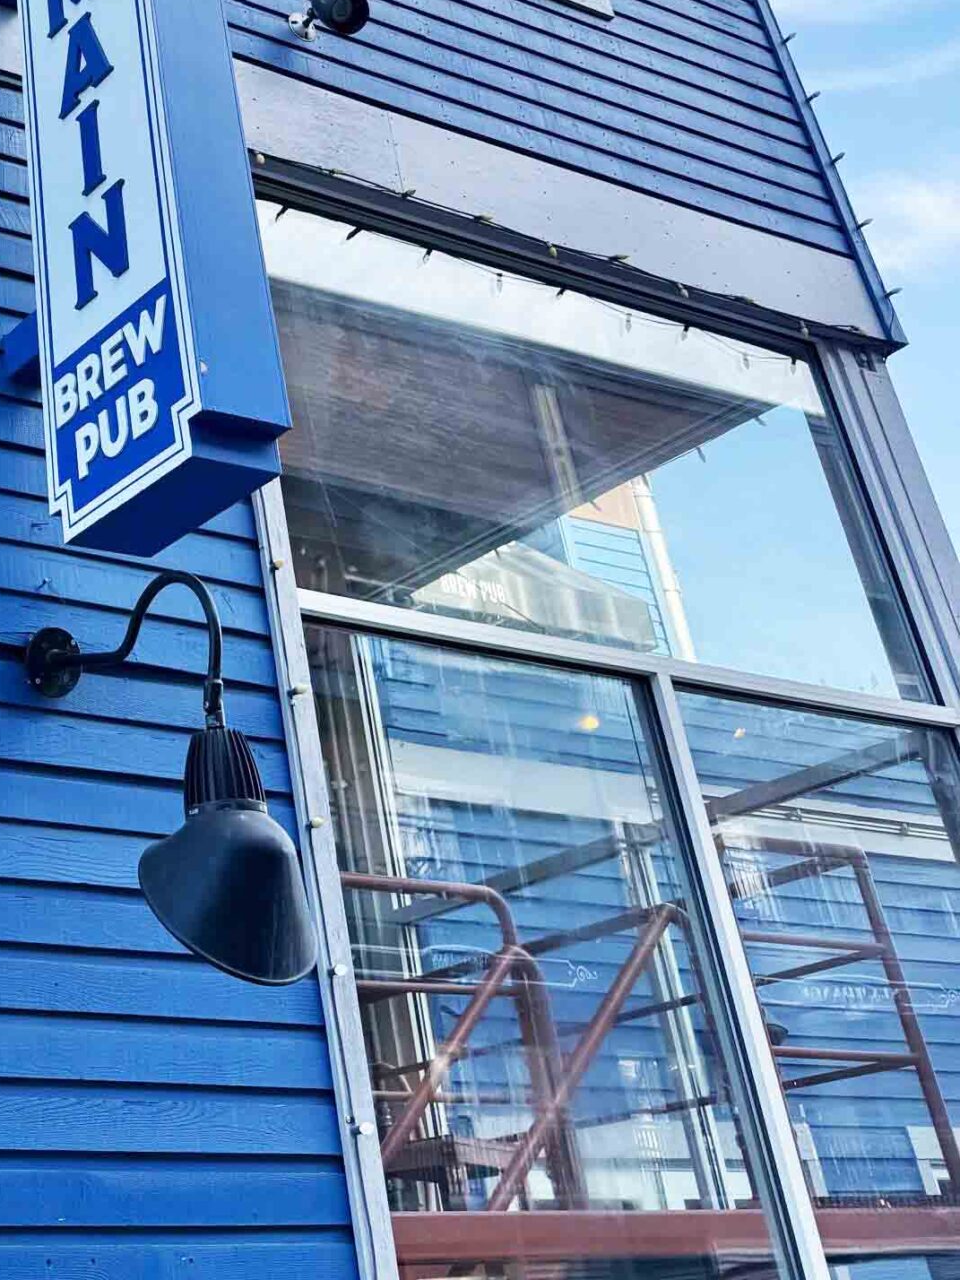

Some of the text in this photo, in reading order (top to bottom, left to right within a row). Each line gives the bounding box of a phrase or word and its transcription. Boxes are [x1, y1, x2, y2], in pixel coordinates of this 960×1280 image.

[54, 293, 168, 430] BREW
[74, 378, 159, 480] PUB
[480, 579, 506, 604] PUB
